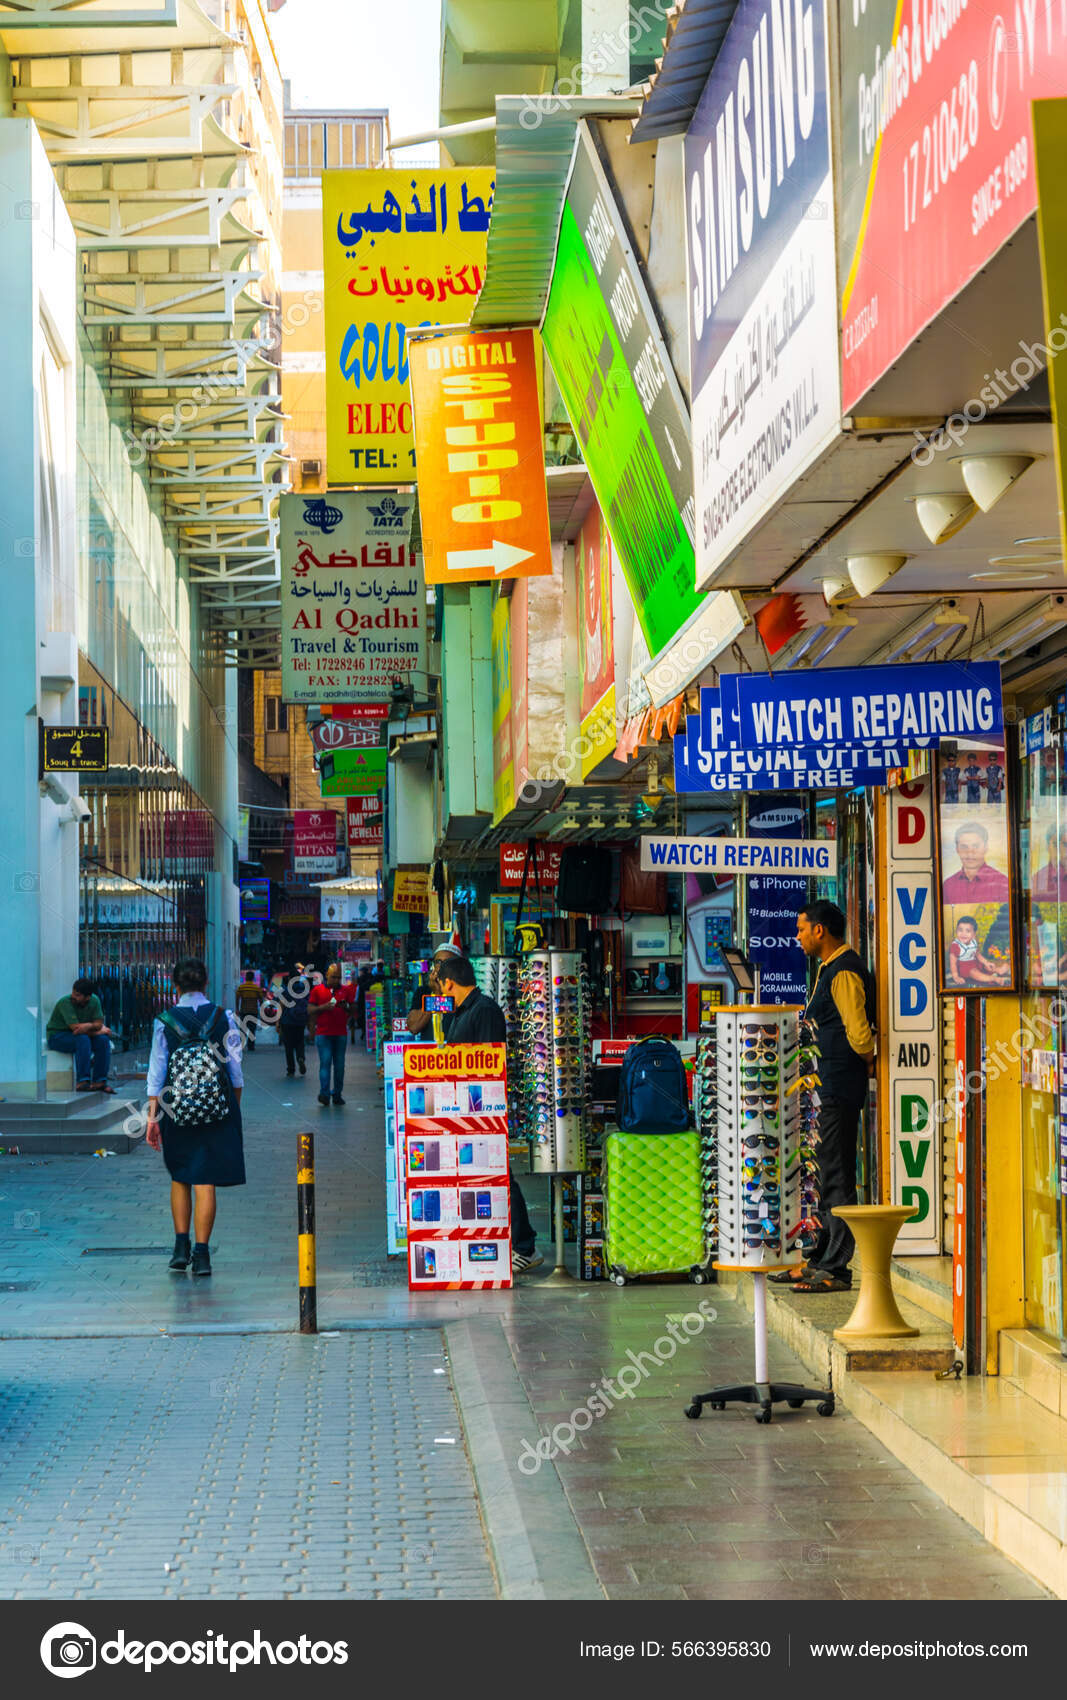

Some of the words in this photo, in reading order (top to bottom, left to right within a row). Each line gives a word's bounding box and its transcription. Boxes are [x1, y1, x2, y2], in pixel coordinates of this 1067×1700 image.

[858, 24, 909, 167] Perfumes
[903, 141, 919, 232] 17
[923, 59, 978, 209] 210628
[691, 0, 814, 341] SAMSUNG
[971, 165, 1002, 236] SINCE
[1004, 135, 1028, 198] 1989
[337, 179, 447, 259] الذهبي
[585, 191, 615, 276] DIGITAL
[347, 264, 487, 303] لكترونيات
[426, 341, 517, 370] DIGITAL
[633, 335, 665, 416] SERVICE
[347, 402, 412, 434] ELEC
[350, 449, 398, 468] TEL:
[441, 372, 522, 523] STUDIO
[703, 469, 738, 550] SINGAPORE
[740, 399, 792, 502] ELECTRONICS
[373, 517, 404, 527] IATA
[291, 538, 417, 578] القاضي
[290, 580, 352, 605] والسياحة
[355, 579, 418, 604] للسفريات
[292, 608, 323, 630] Al
[335, 607, 420, 637] Qadhi
[291, 638, 336, 654] Travel
[343, 638, 357, 654] &
[358, 638, 420, 654] Tourism
[291, 658, 312, 672] Tel:
[316, 657, 366, 671] 17228246
[369, 657, 419, 671] 17228247
[308, 676, 340, 686] FAX:
[751, 697, 844, 745] WATCH
[852, 686, 995, 740] REPAIRING
[70, 740, 83, 758] 4
[50, 758, 69, 768] Souq
[710, 771, 758, 790] GET
[793, 768, 854, 788] FREE
[362, 798, 379, 811] AND
[756, 814, 799, 823] SAMSUNG
[296, 845, 335, 856] TITAN
[649, 843, 717, 866] WATCH
[724, 845, 829, 868] REPAIRING
[763, 877, 807, 889] iPhone
[896, 887, 929, 1017] VCD
[763, 973, 792, 982] MOBILE
[409, 1050, 462, 1072] special
[465, 1049, 500, 1069] offer
[897, 1043, 931, 1067] AND
[899, 1094, 931, 1223] DVD
